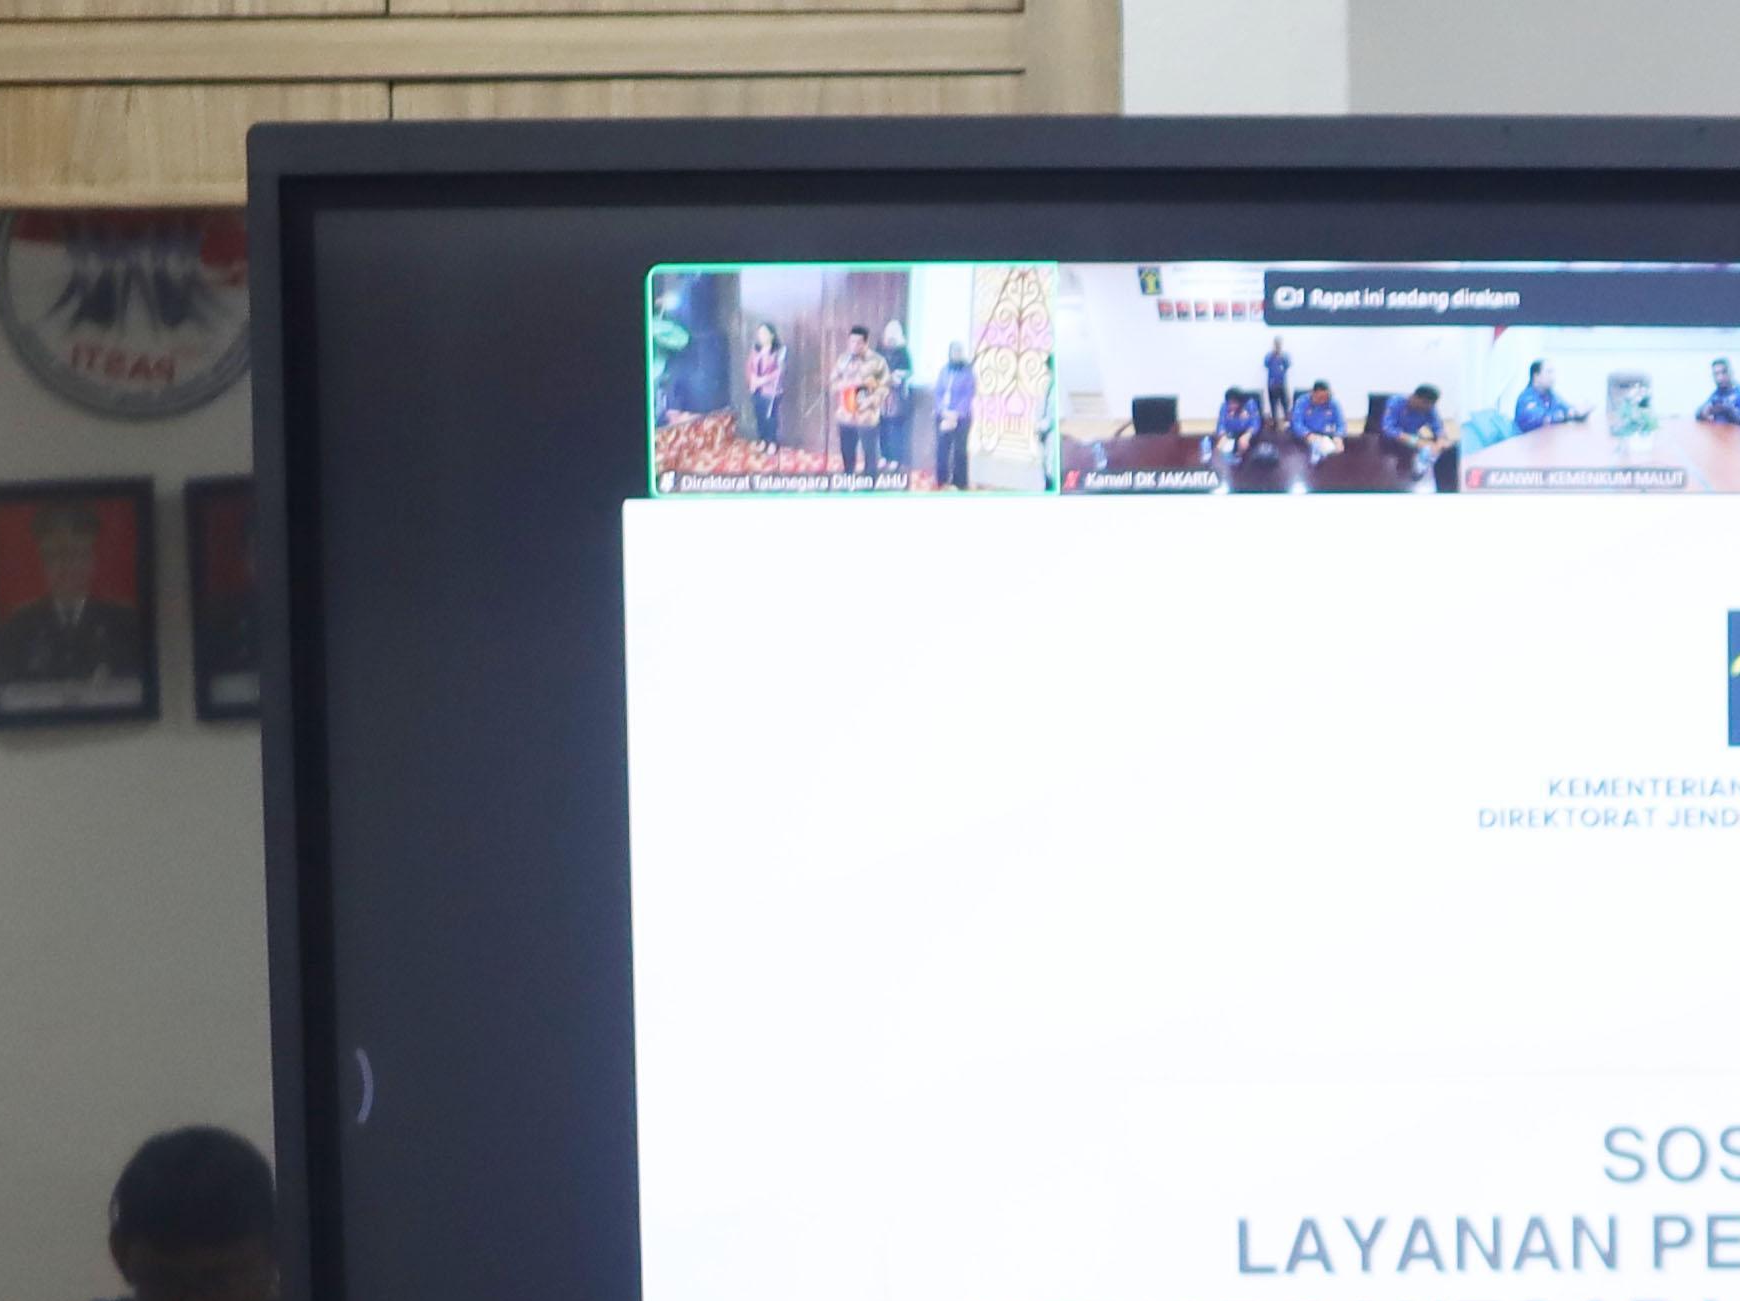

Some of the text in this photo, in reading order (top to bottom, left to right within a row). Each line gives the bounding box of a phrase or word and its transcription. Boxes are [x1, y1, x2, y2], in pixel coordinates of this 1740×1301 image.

[1311, 287, 1520, 310] Rapat ini sedang direkam
[681, 473, 749, 490] Direktorat
[753, 473, 828, 491] Tatanegara
[875, 473, 908, 490] AHU
[1085, 471, 1132, 488] Kanwil
[1158, 471, 1219, 488] JAKARTA
[1489, 470, 1544, 487] KANWIL
[1634, 470, 1684, 486] MALUT
[1478, 807, 1660, 830] DIREKTORAT
[1236, 1214, 1621, 1276] LAYANAN
